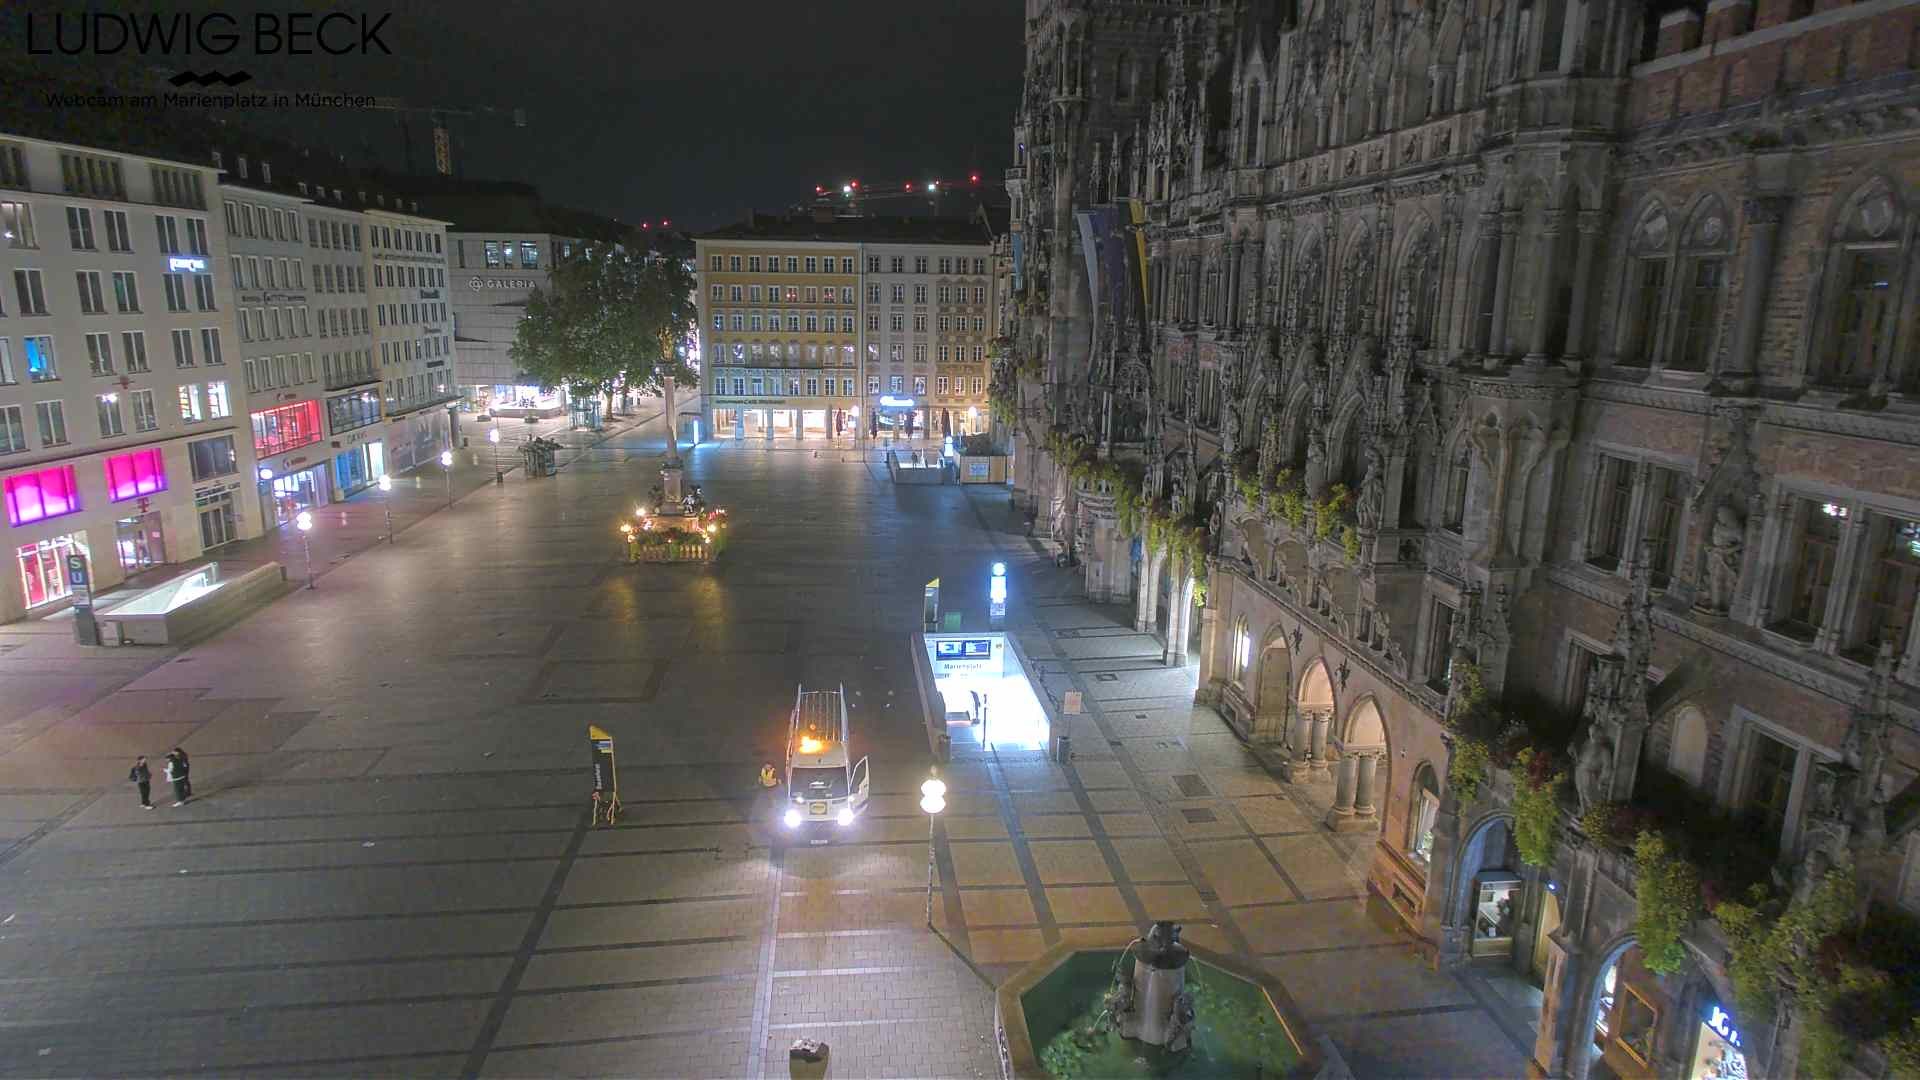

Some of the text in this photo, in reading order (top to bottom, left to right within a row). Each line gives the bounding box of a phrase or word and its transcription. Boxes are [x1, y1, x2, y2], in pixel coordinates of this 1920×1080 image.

[487, 280, 536, 288] GALERIA
[70, 557, 81, 569] S
[71, 571, 82, 584] U
